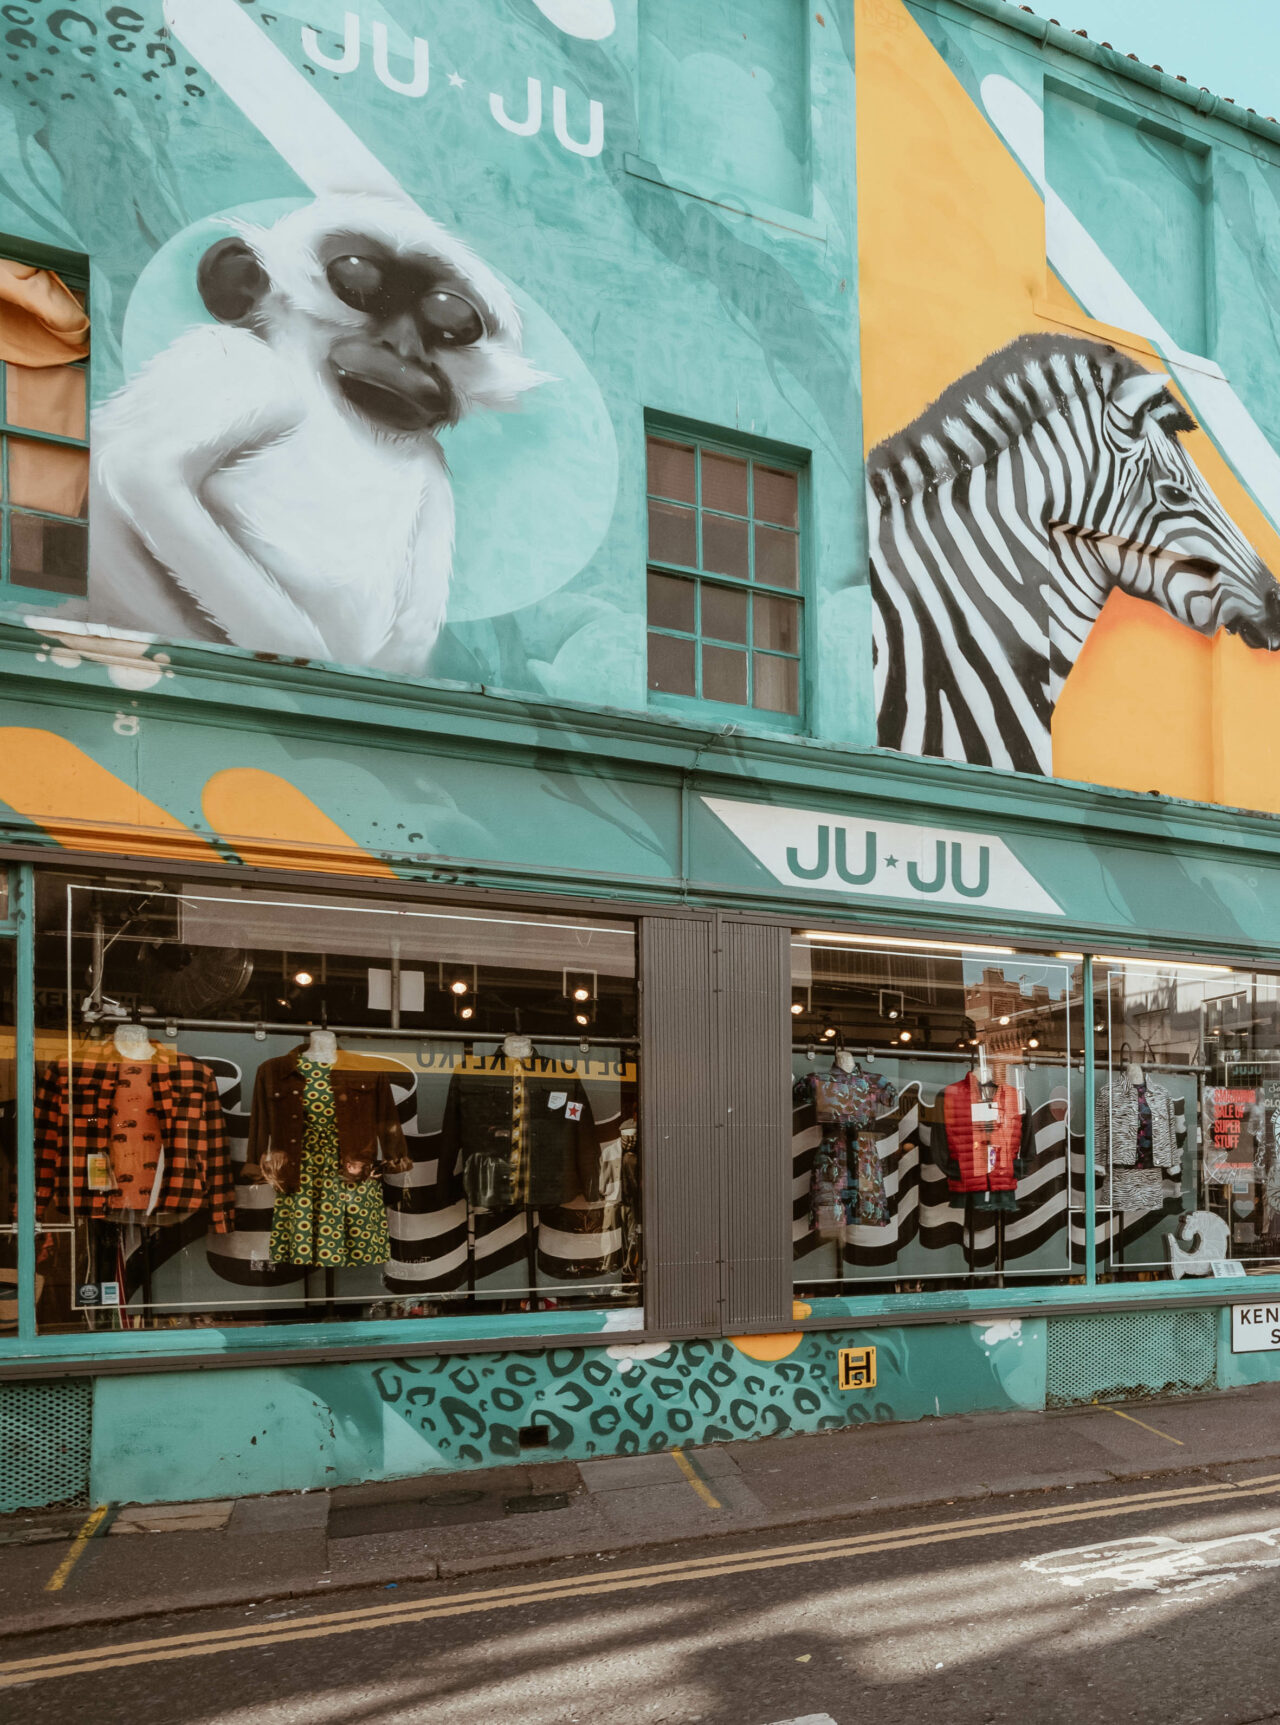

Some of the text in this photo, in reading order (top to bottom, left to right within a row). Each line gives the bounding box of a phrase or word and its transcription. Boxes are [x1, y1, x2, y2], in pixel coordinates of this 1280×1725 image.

[1214, 1104, 1245, 1118] SALE OF
[1214, 1120, 1241, 1134] SUPER
[1214, 1135, 1240, 1149] STUFF
